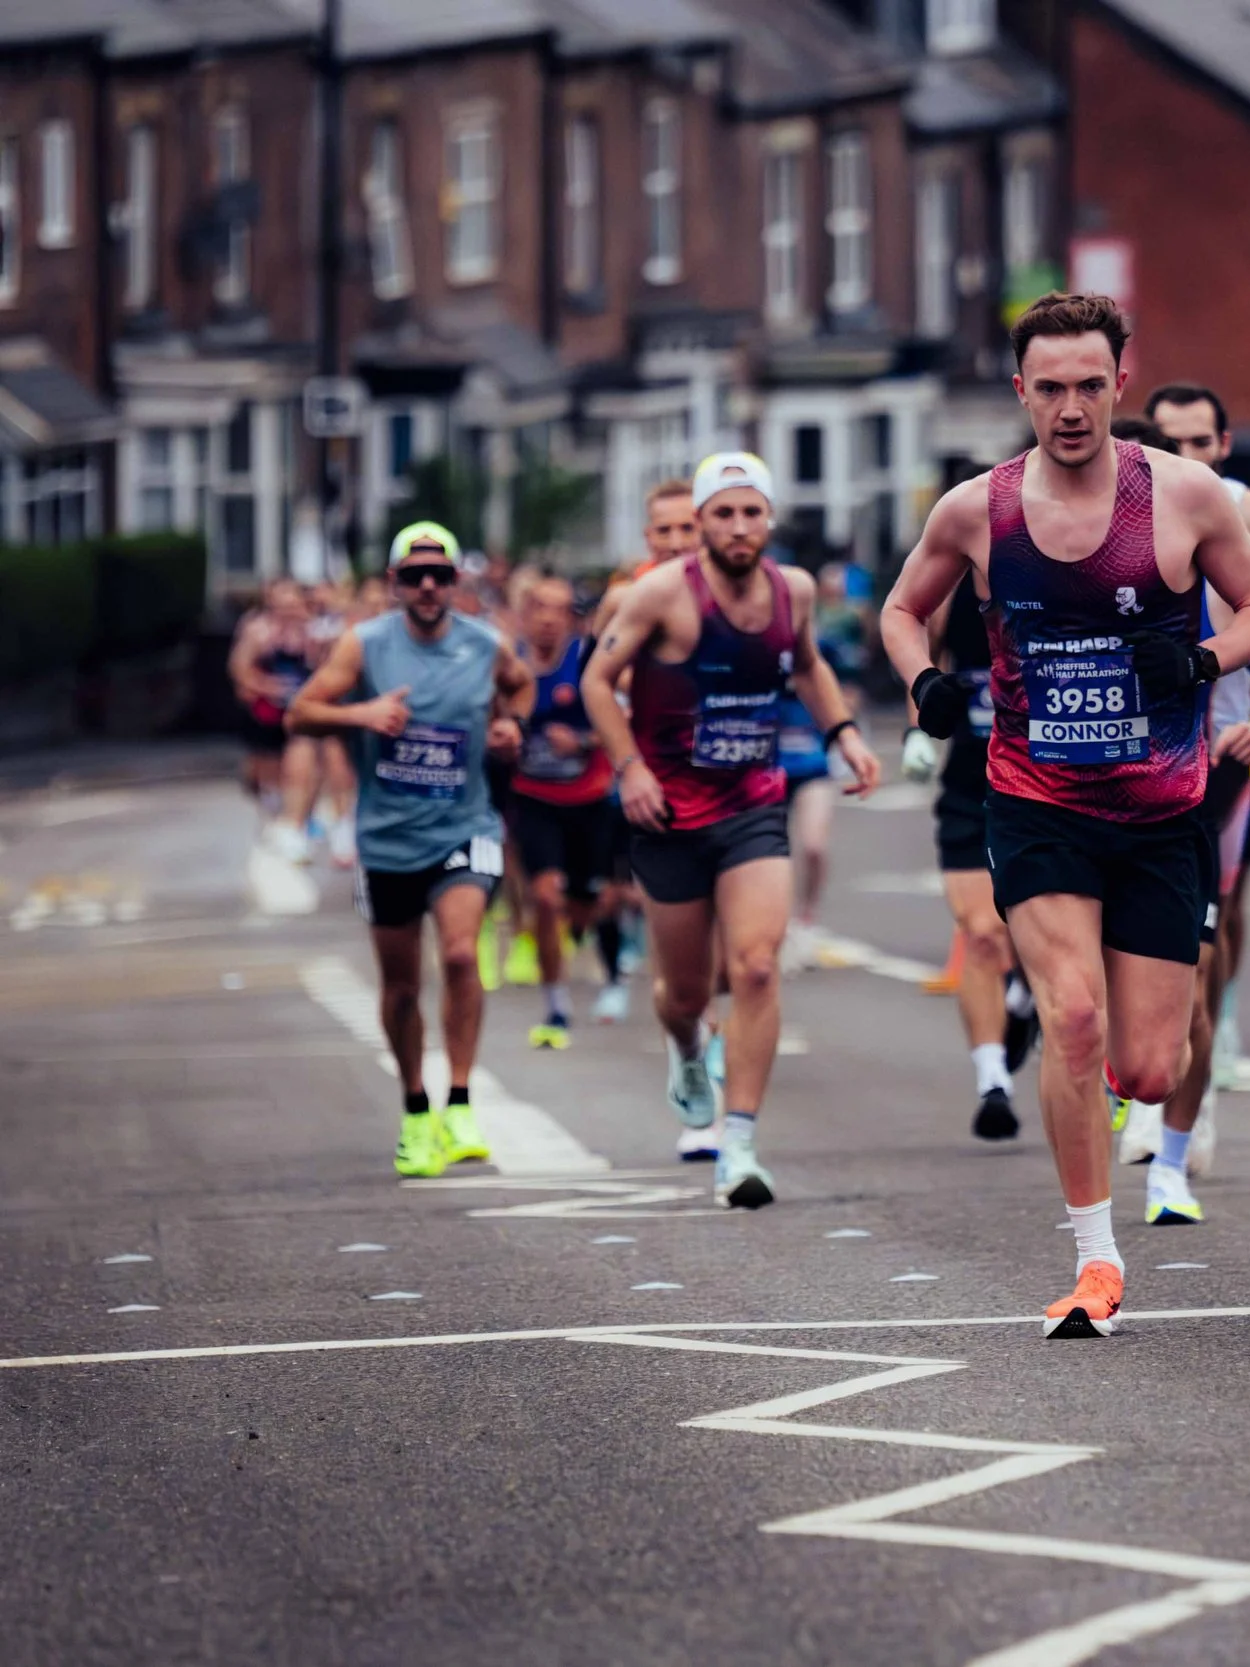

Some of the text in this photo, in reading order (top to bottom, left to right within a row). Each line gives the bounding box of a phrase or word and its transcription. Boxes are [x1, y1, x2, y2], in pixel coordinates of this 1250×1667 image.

[1066, 636, 1123, 653] HAPP
[1055, 662, 1096, 671] SHEFFIELD
[1055, 668, 1129, 679] HALF MARATHON
[1046, 686, 1125, 714] 3958
[1041, 721, 1134, 741] CONNOR
